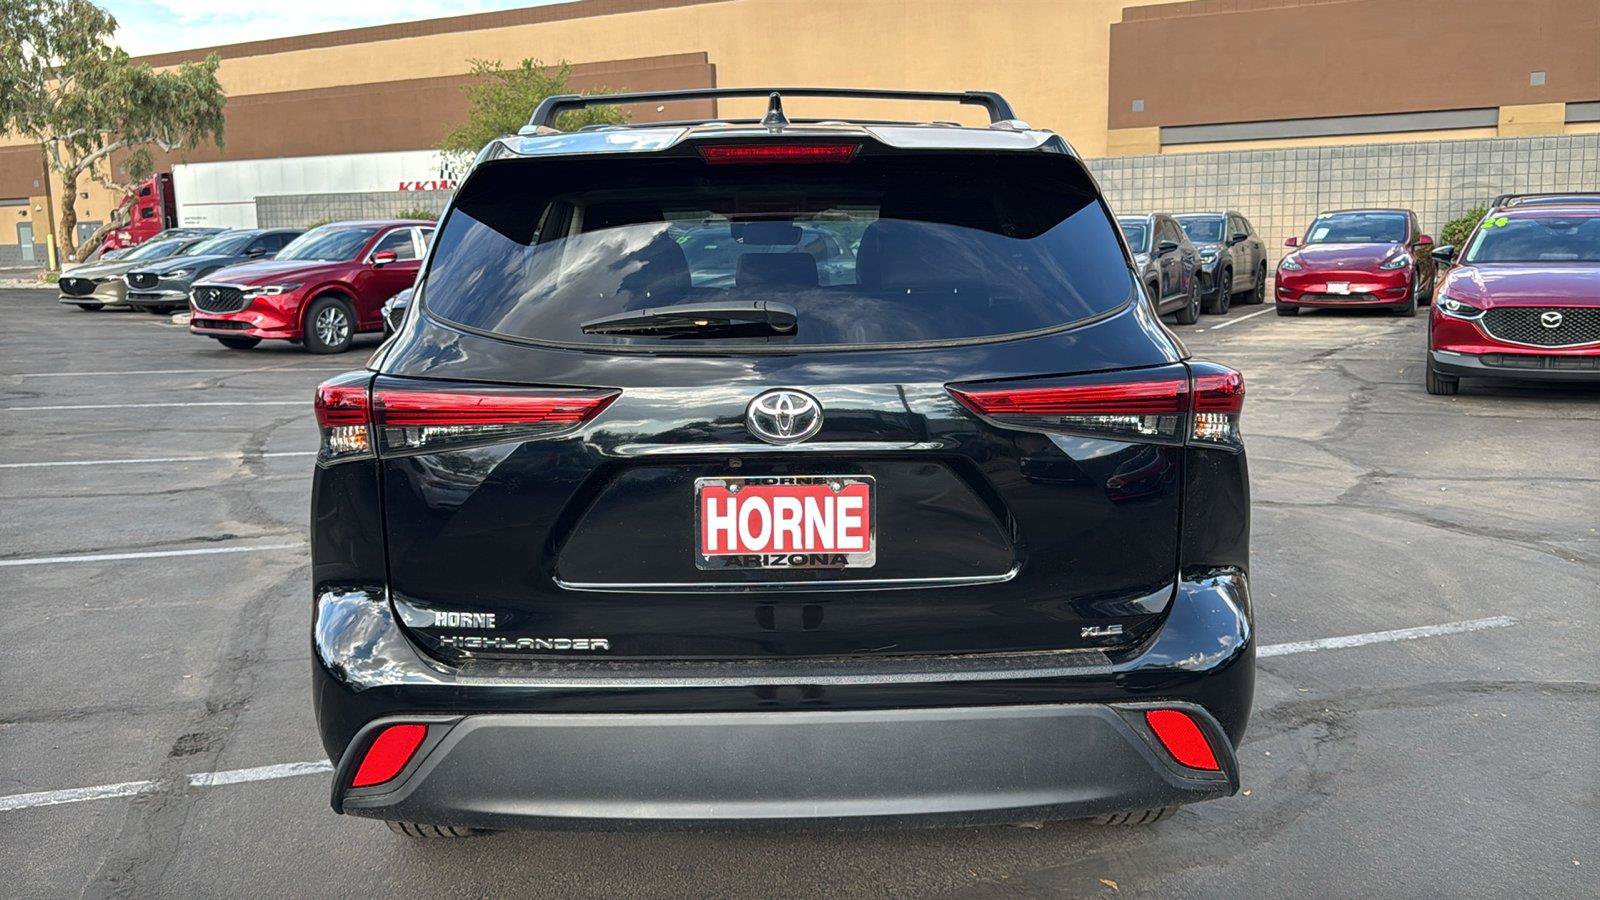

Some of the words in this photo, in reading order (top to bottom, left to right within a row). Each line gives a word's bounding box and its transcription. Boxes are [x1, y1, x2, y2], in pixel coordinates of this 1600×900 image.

[744, 477, 827, 485] HORNE
[706, 496, 864, 551] HORNE
[724, 554, 849, 567] ARIZONA
[434, 611, 496, 628] HORNE
[1080, 624, 1123, 638] XLE
[439, 635, 609, 650] HIGHLANDER
